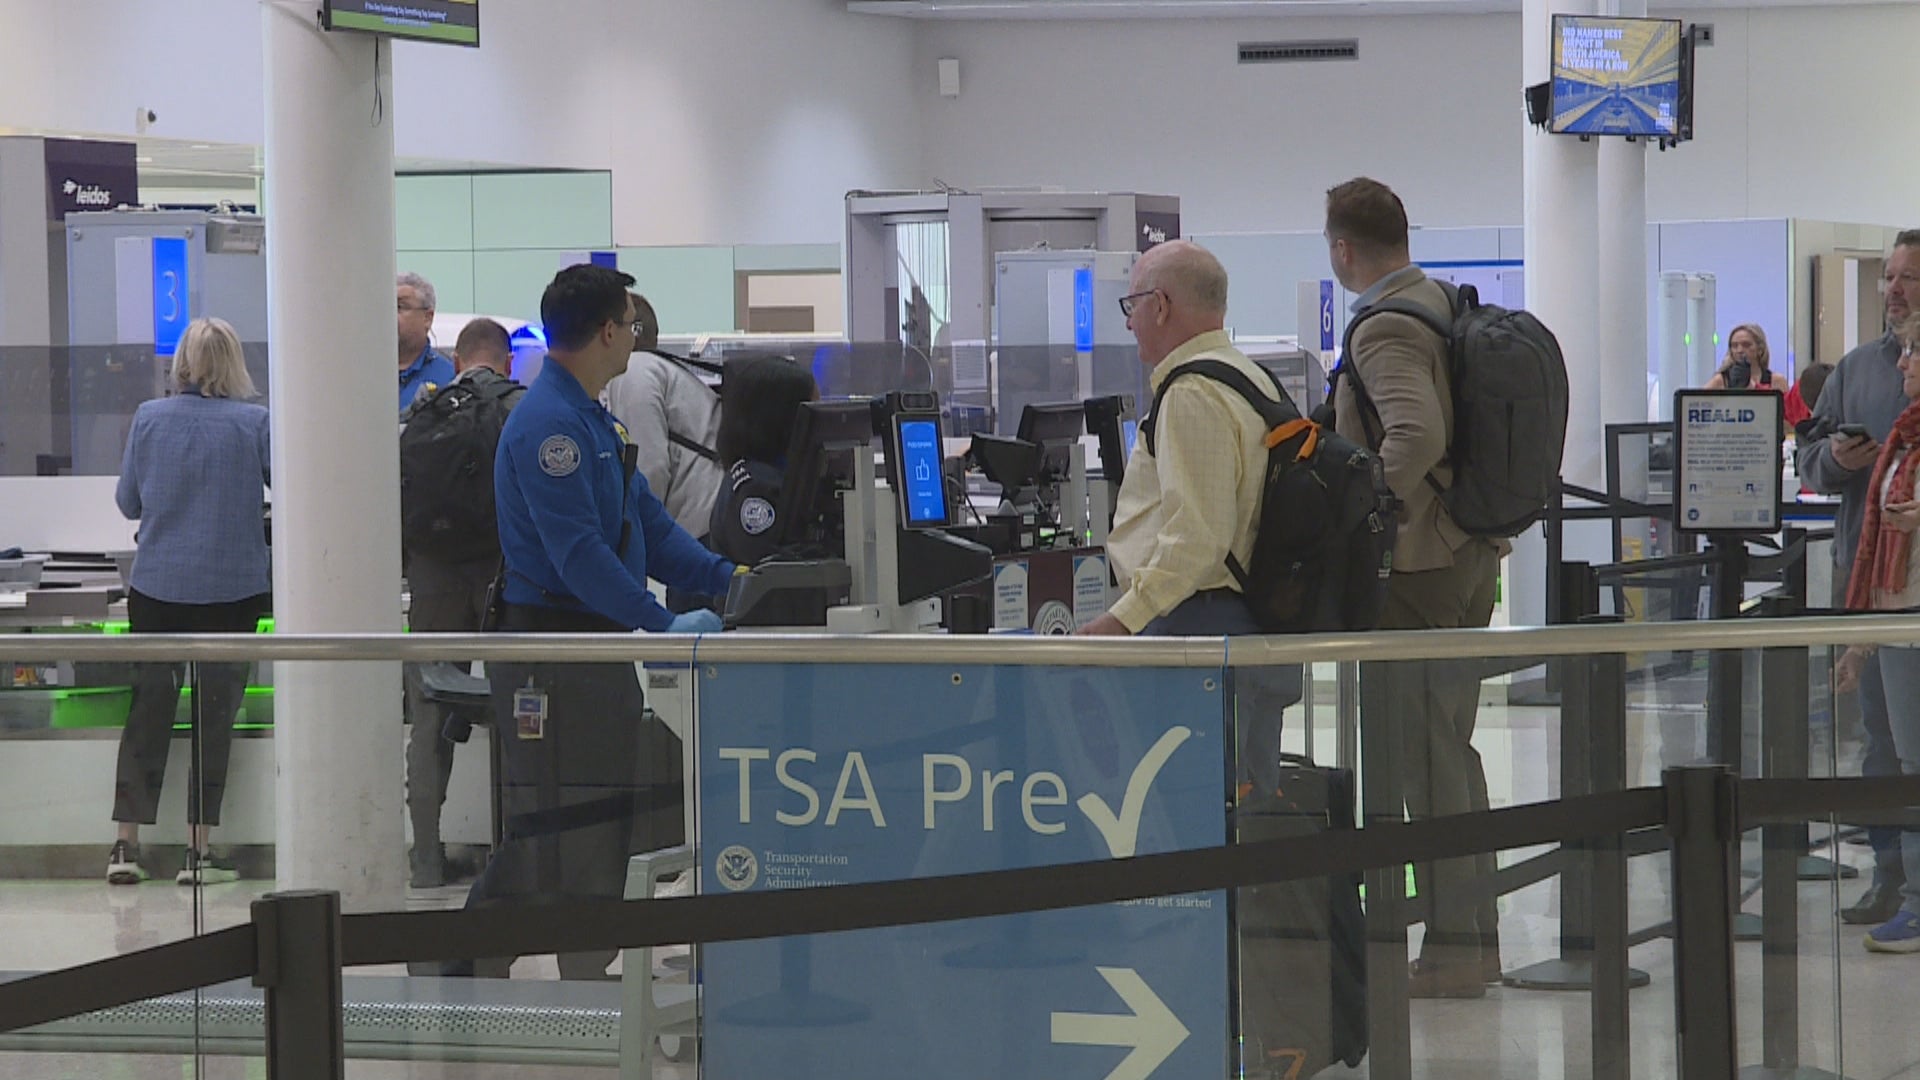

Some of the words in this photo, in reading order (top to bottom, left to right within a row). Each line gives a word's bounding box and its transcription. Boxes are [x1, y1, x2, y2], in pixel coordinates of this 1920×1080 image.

[1563, 38, 1594, 48] AIRPORT
[1562, 48, 1587, 58] NORTH
[1588, 49, 1620, 60] AMERICA
[76, 185, 110, 205] leidos
[162, 270, 179, 322] 3
[1322, 299, 1332, 333] 6
[1688, 409, 1736, 423] REAL
[1738, 409, 1756, 423] ID
[718, 746, 887, 828] TSA
[922, 753, 1068, 835] Pre
[764, 850, 848, 865] Transportation
[765, 864, 811, 877] Security
[1145, 897, 1155, 905] to
[1158, 898, 1173, 908] get
[1175, 898, 1212, 908] started
